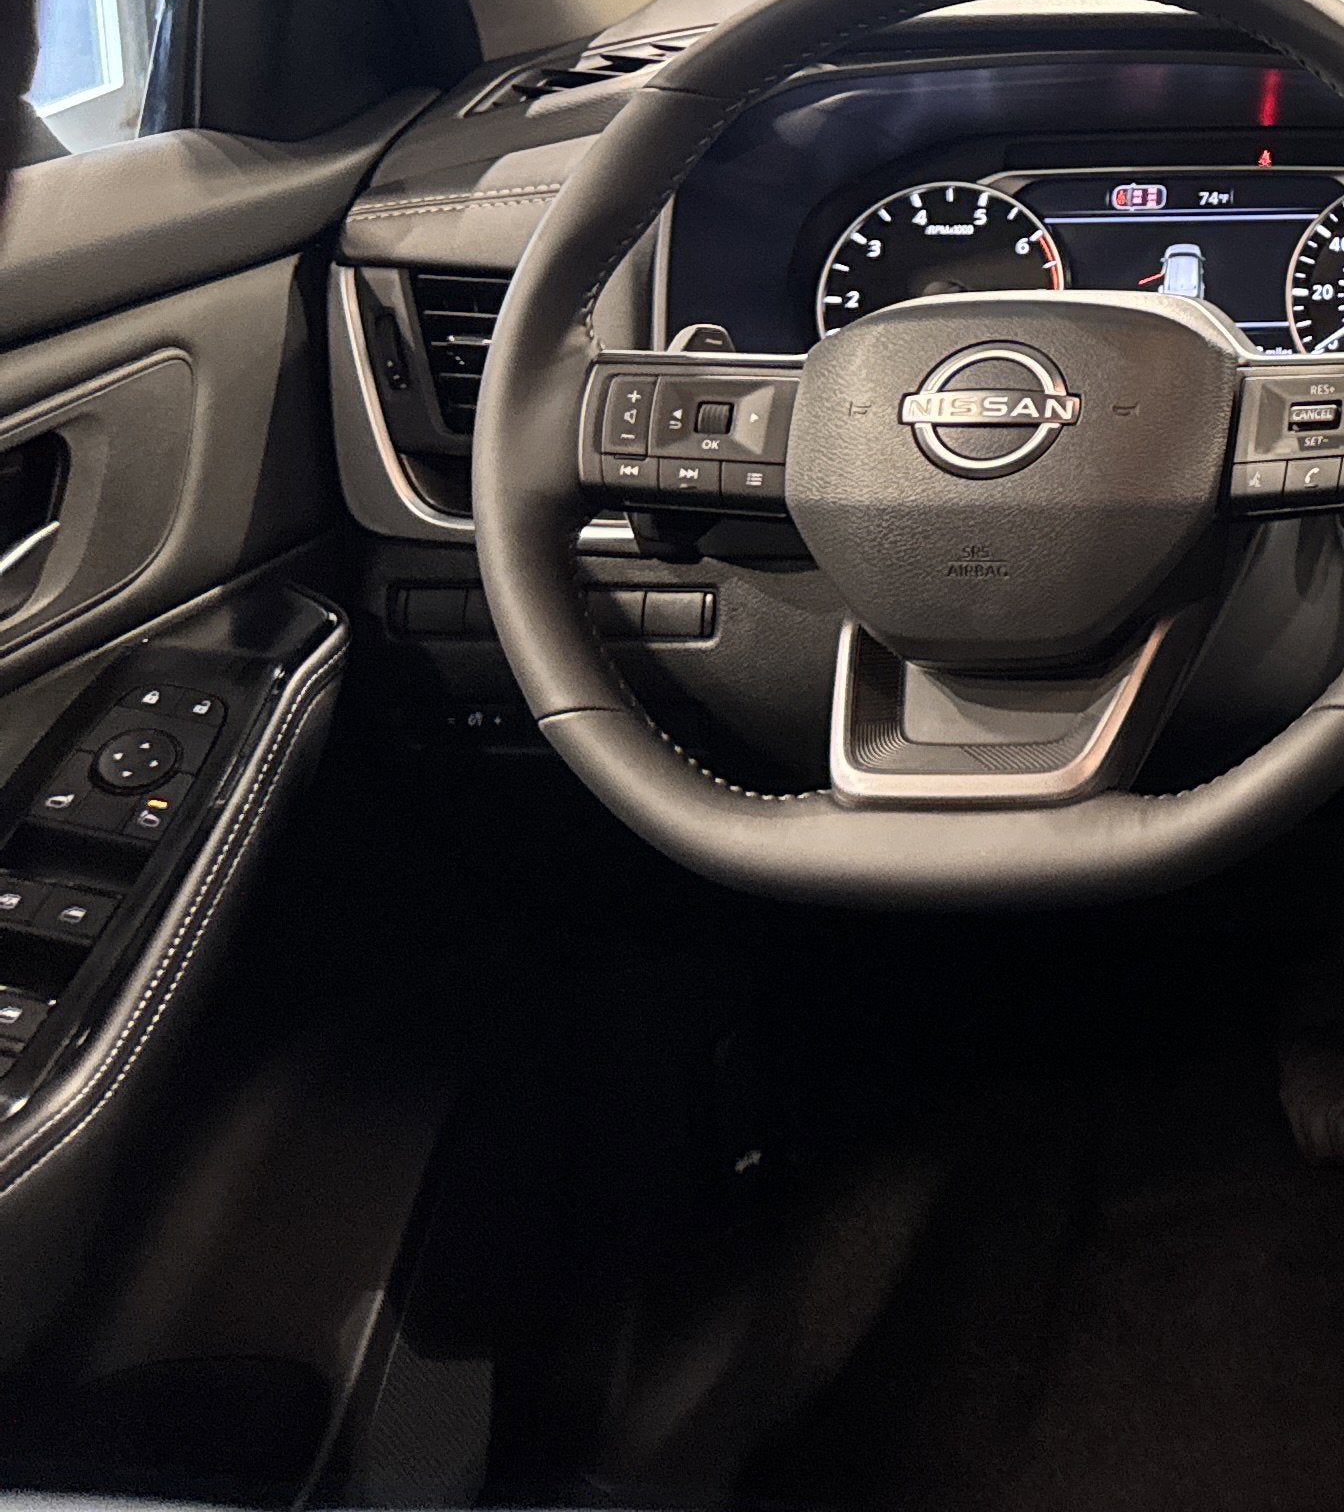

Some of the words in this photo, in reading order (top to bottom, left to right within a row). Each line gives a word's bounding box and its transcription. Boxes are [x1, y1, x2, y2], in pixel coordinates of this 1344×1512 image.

[911, 209, 928, 226] 4
[973, 208, 988, 225] 5
[866, 239, 881, 257] 3
[1014, 237, 1030, 255] 6
[844, 291, 860, 308] 2
[1311, 284, 1334, 300] 20
[1310, 385, 1336, 396] RES+
[908, 396, 1074, 420] NISSAN
[1292, 409, 1333, 420] CANCEL
[701, 439, 720, 451] OK
[961, 546, 992, 560] SRS
[947, 563, 1008, 578] AIRBAG
